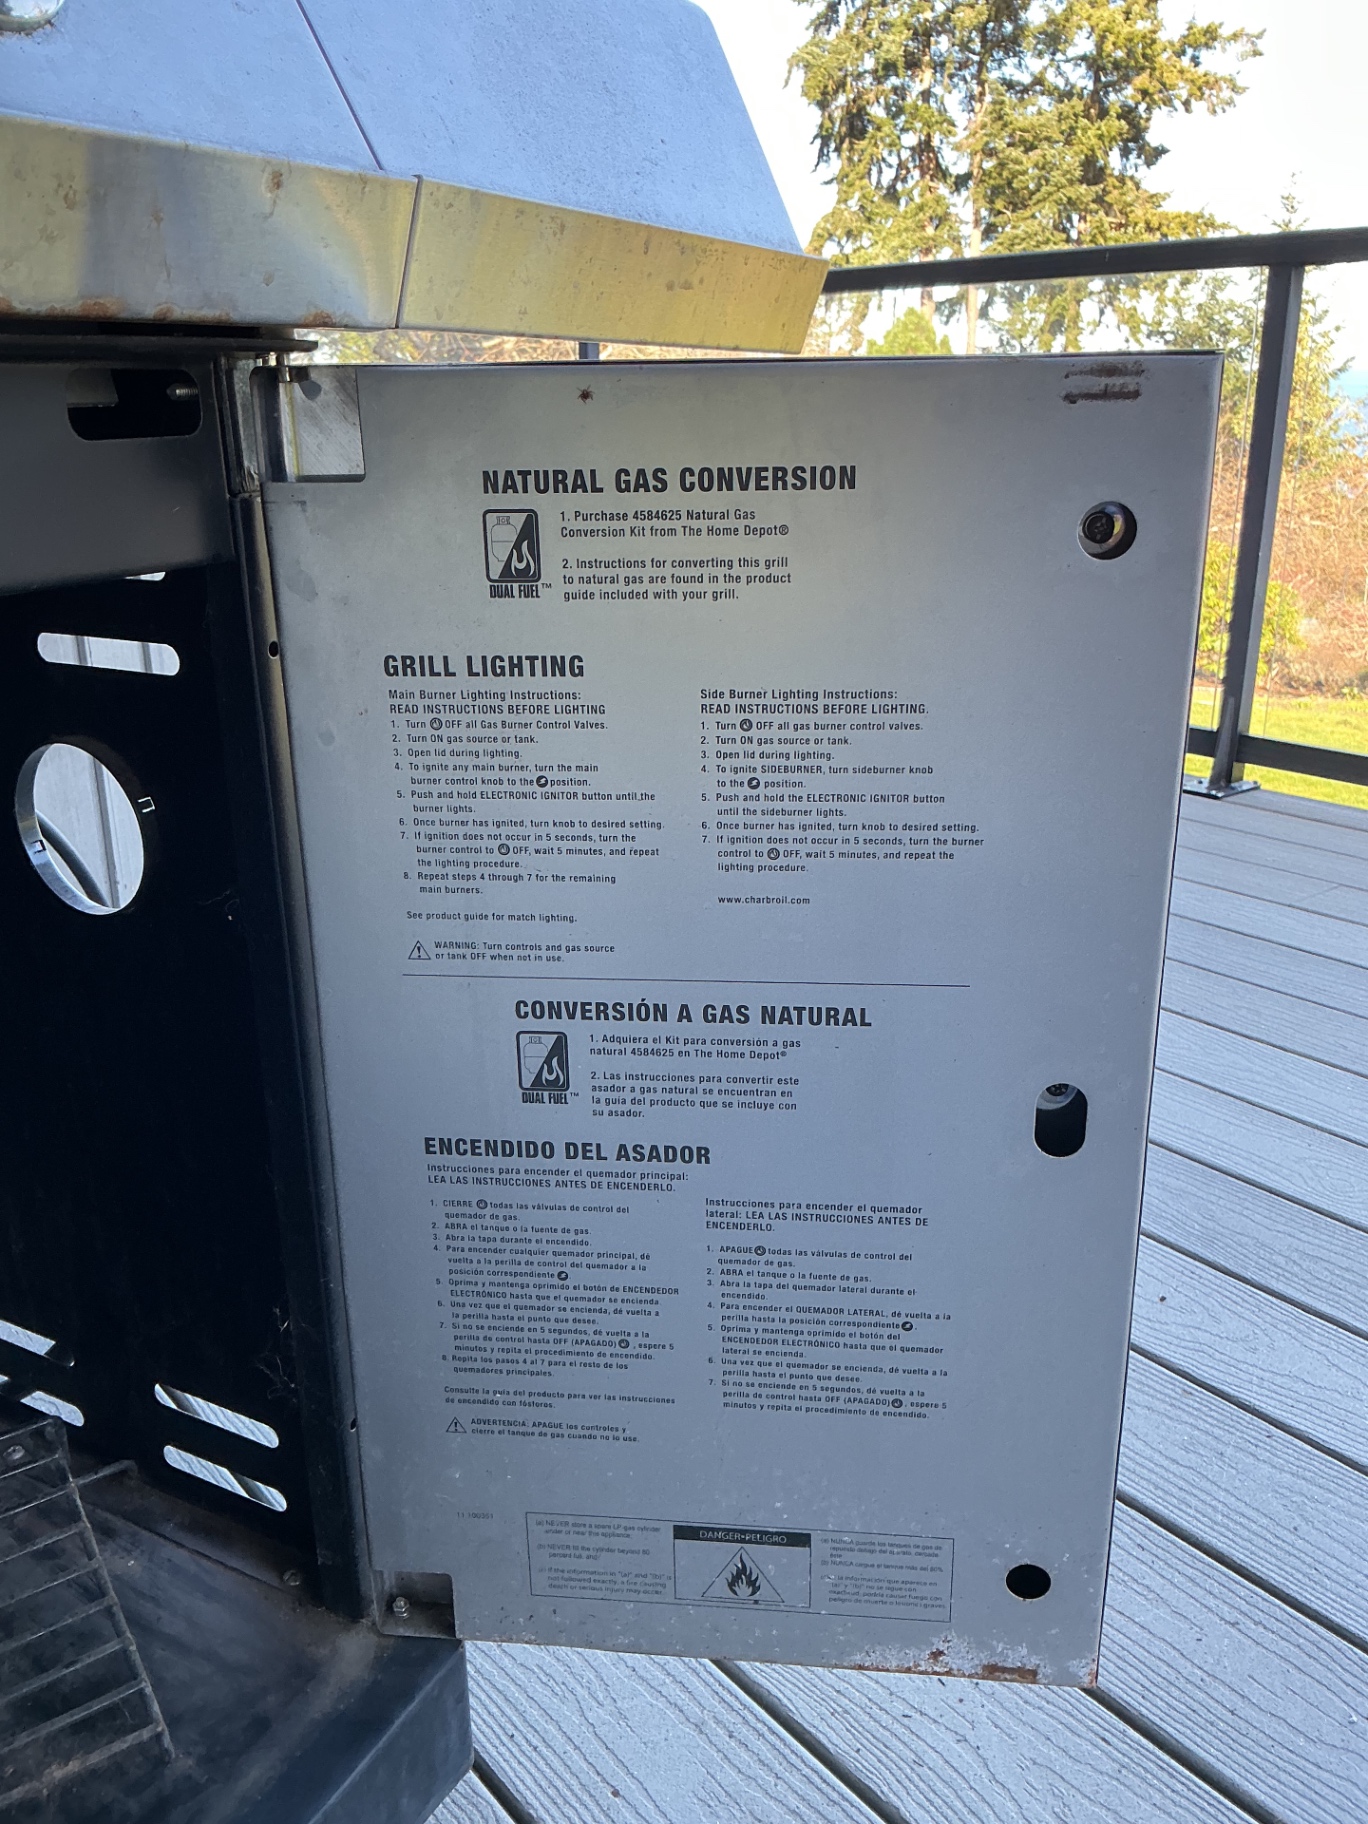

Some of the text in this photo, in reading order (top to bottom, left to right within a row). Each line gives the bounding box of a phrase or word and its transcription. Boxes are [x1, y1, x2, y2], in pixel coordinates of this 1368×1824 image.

[482, 465, 856, 494] NATURAL GAS CONVERSION
[560, 508, 755, 521] 1. Purchase 4584625 Natural Gas
[560, 526, 625, 538] Conversion
[629, 525, 646, 537] Kit
[649, 525, 677, 537] from
[680, 525, 702, 536] The
[706, 525, 739, 536] Home
[562, 556, 788, 570] 2. Instructions for converting this grill
[562, 572, 791, 586] to natural gas are found in the product
[563, 588, 738, 602] guide included with your grill.
[383, 654, 584, 677] GRILL LIGHTING
[388, 689, 581, 702] Main Burner Lighting Instructions:
[700, 688, 897, 701] Side Burner Lighting Instructions:
[389, 703, 605, 715] READ INSTRUCTIONS BEFORE LIGHTING
[700, 703, 928, 714] READ INSTRUCTIONS BEFORE LIGHTING.
[391, 719, 608, 729] 1. Turn OFF all Gas Burner Control Valves.
[700, 721, 923, 732] 1. Turn OFF all gas burner control valves.
[393, 748, 522, 759] 3. Open lid during lighting.
[717, 895, 810, 904] www.charbroil.com
[406, 910, 577, 924] See product guide for match lighting.
[434, 940, 479, 949] WARNING:
[482, 941, 502, 950] Turn
[505, 943, 542, 951] controls
[545, 943, 562, 951] and
[564, 945, 581, 953] gas
[447, 952, 467, 960] tank
[470, 952, 486, 960] OFF
[489, 952, 514, 961] when
[517, 953, 531, 961] not
[534, 953, 543, 961] in
[514, 998, 872, 1027] CONVERSIÓN A GAS NATURAL
[589, 1034, 801, 1049] 1. Adquiera el Kit para conversión a gas
[589, 1046, 626, 1056] natural
[630, 1047, 674, 1057] 4584625
[694, 1049, 712, 1058] The
[716, 1049, 745, 1059] Home
[424, 1136, 710, 1164] ENCENDIDO DEL ASADOR
[427, 1163, 688, 1182] Instrucciones para encender el quemador principal:
[428, 1174, 675, 1192] LEA LAS INSTRUCCIONES ANTES DE ENCENDERLO.
[443, 1199, 473, 1208] CIERRE
[489, 1202, 513, 1210] todas
[516, 1202, 529, 1210] las
[531, 1203, 567, 1211] válvulas
[582, 1205, 613, 1213] control
[616, 1206, 629, 1214] del
[705, 1197, 922, 1214] Instrucciones para encender el quemador
[705, 1209, 928, 1226] lateral: LEA LAS INSTRUCCIONES ANTES DE
[706, 1220, 775, 1231] ENCENDERLO.
